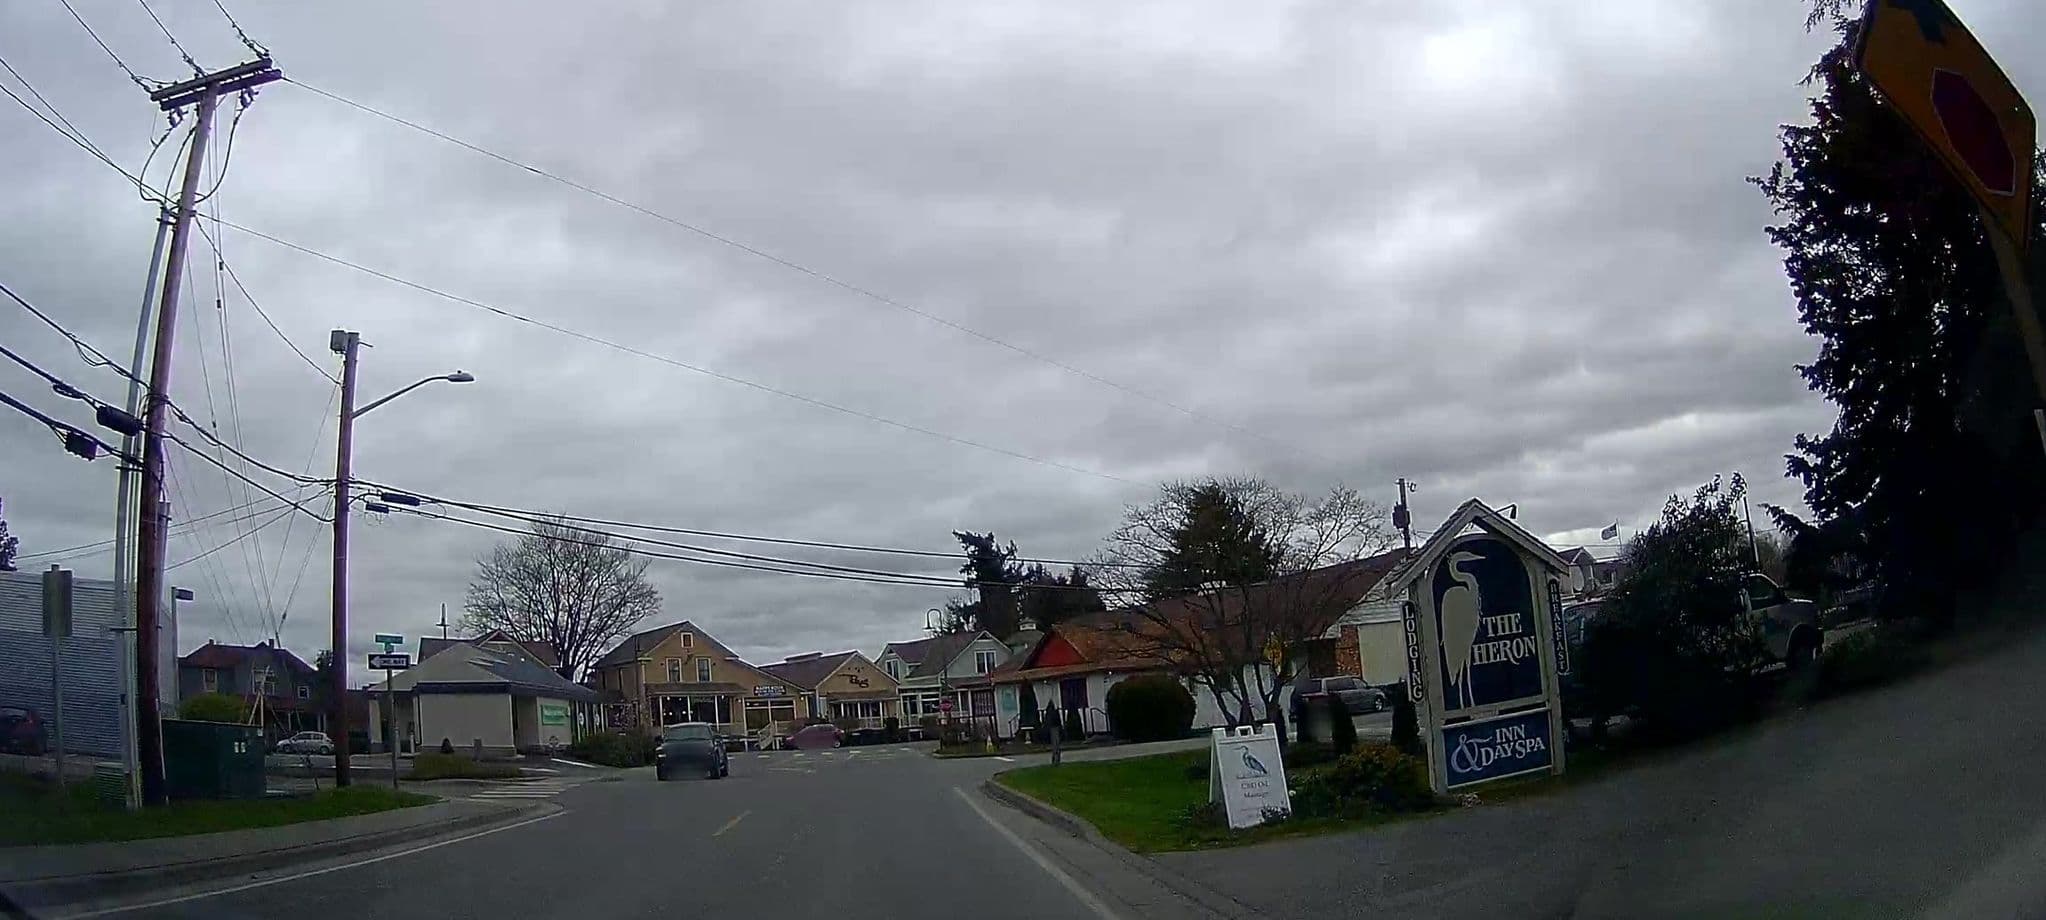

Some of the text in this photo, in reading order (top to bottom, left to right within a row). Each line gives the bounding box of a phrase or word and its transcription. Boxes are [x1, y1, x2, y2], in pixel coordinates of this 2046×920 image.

[1482, 612, 1522, 637] THE
[1551, 583, 1565, 670] BREAKFAST
[1404, 605, 1422, 698] LODGING
[1472, 635, 1536, 666] HERON
[1495, 724, 1525, 743] INN
[1450, 733, 1493, 773] &
